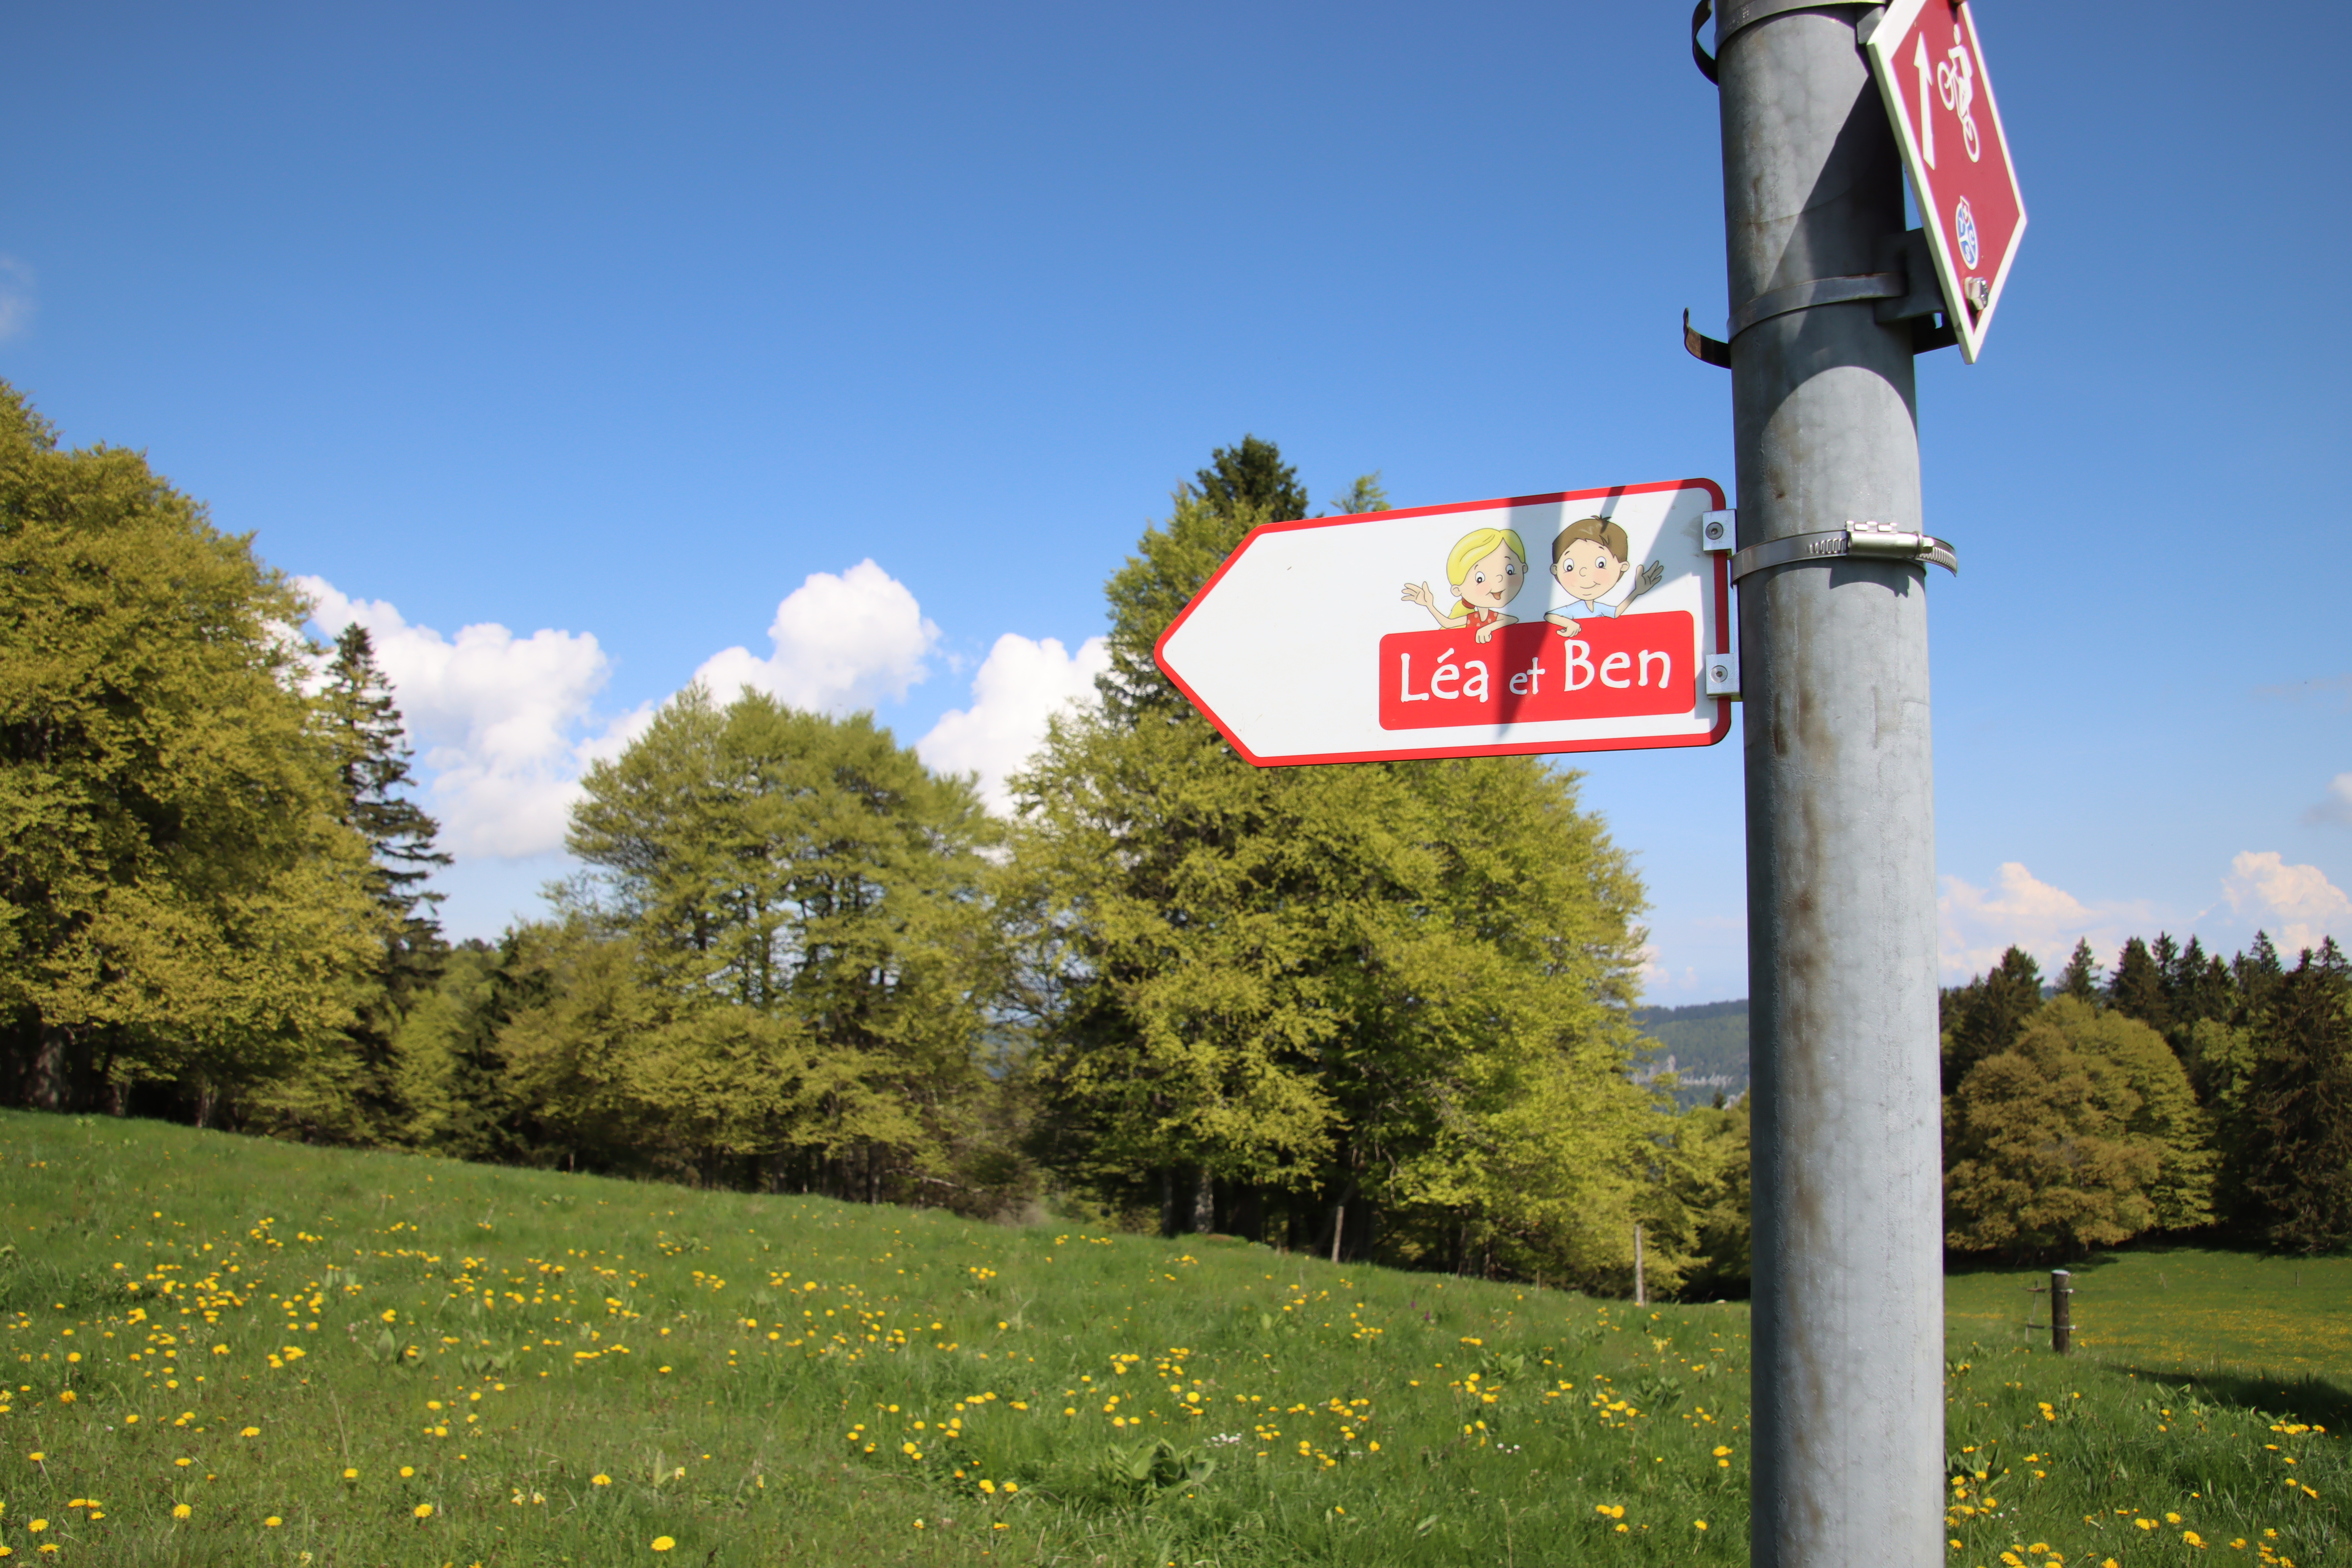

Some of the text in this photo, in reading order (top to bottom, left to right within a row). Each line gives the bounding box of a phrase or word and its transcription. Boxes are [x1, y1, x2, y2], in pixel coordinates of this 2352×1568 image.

[1400, 639, 1671, 703] Léa et Ben
